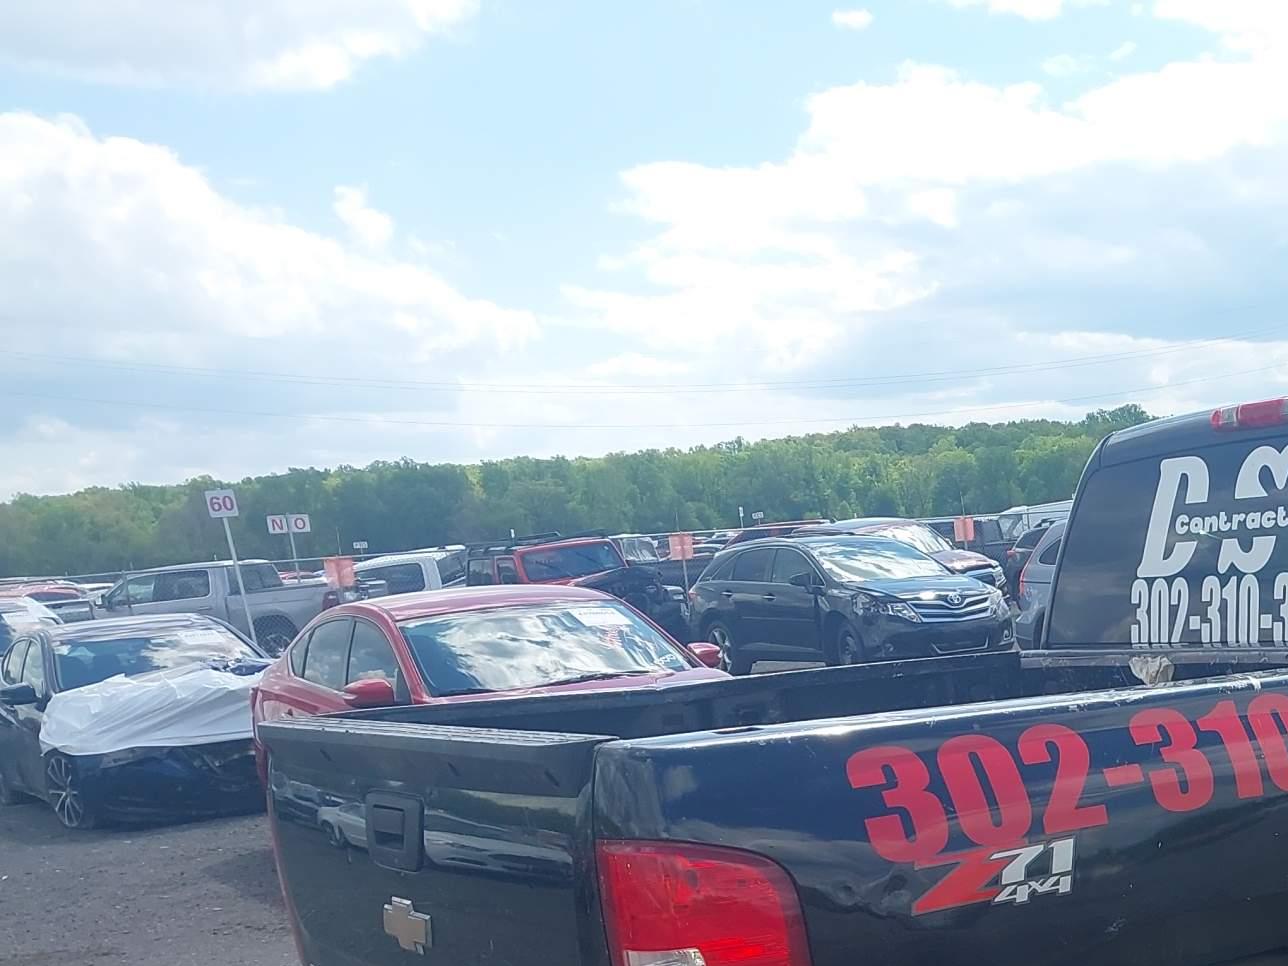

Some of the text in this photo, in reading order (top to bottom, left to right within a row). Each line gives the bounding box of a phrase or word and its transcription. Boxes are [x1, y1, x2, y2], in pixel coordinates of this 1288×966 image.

[209, 495, 234, 512] 60
[271, 518, 284, 531] N
[914, 838, 1075, 916] Z71
